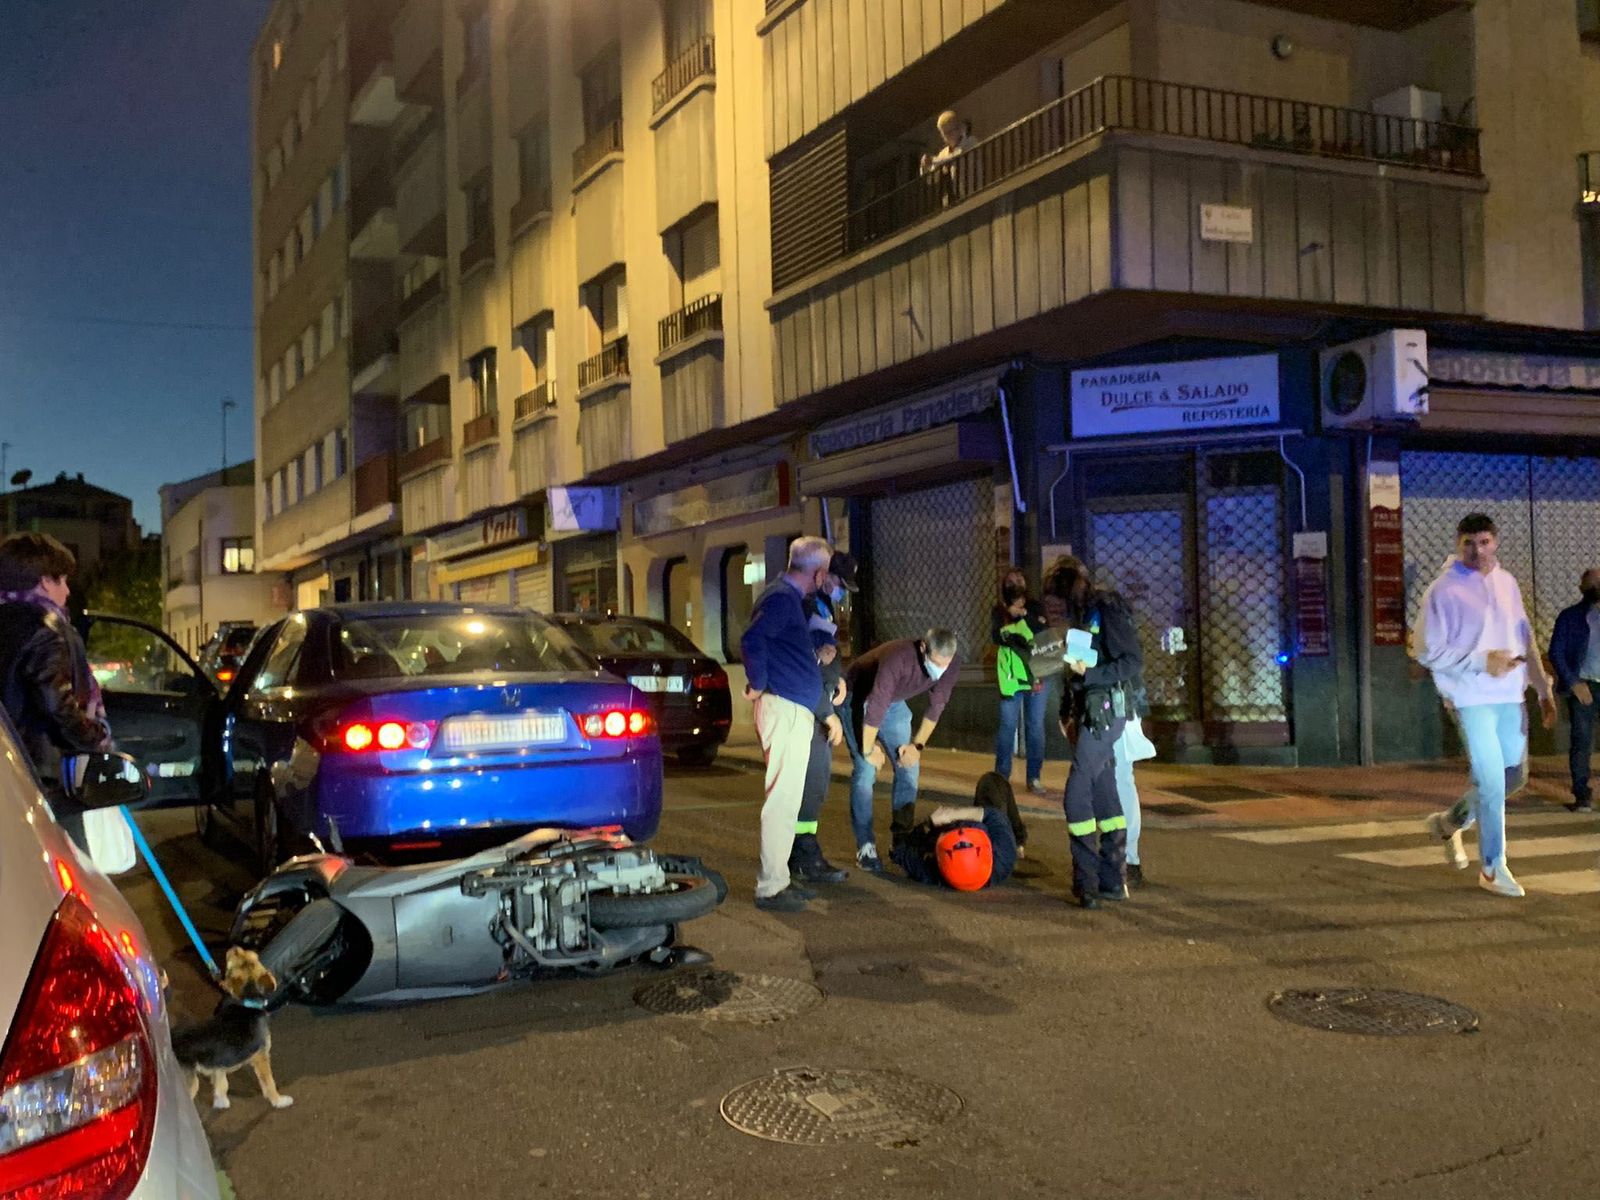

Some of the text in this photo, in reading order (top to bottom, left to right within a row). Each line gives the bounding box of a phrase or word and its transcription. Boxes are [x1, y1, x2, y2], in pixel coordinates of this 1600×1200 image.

[1101, 381, 1249, 406] DULCE & SALADO
